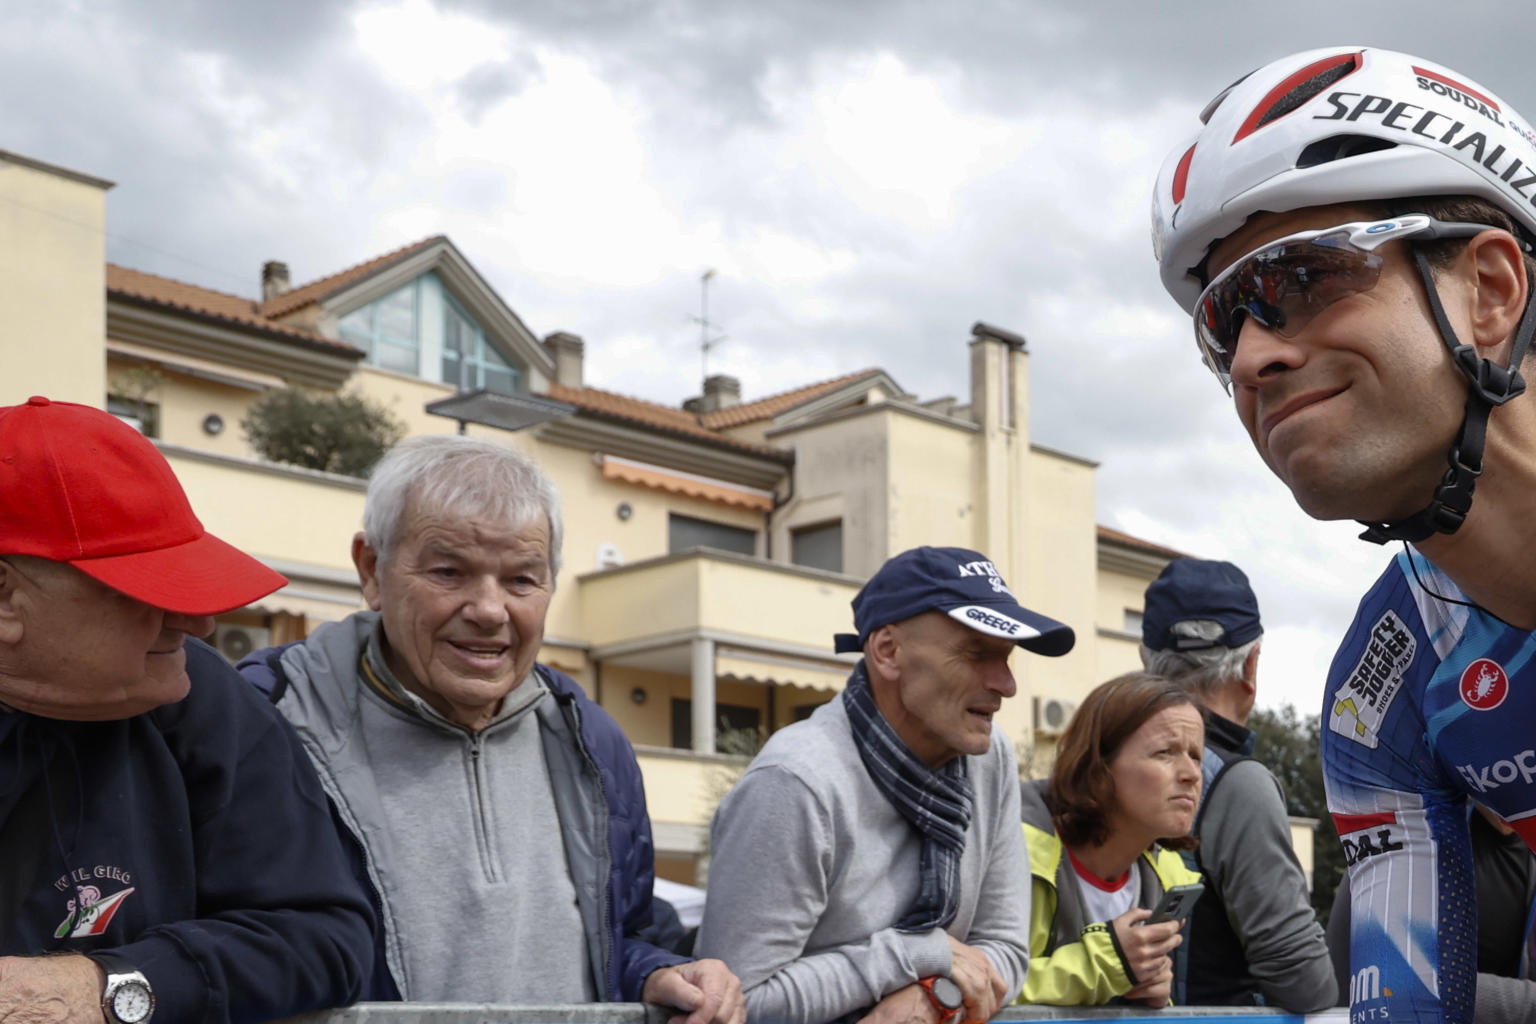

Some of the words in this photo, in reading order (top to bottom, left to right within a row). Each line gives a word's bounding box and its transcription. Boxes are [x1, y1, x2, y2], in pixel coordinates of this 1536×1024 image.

[1416, 76, 1506, 129] SOUDAL
[966, 608, 1021, 635] GREECE
[1348, 615, 1396, 695] SAFETY
[1361, 629, 1410, 707] JOGGER
[1376, 685, 1394, 714] SHOES
[1343, 829, 1404, 866] DAL
[93, 865, 132, 885] GIRO
